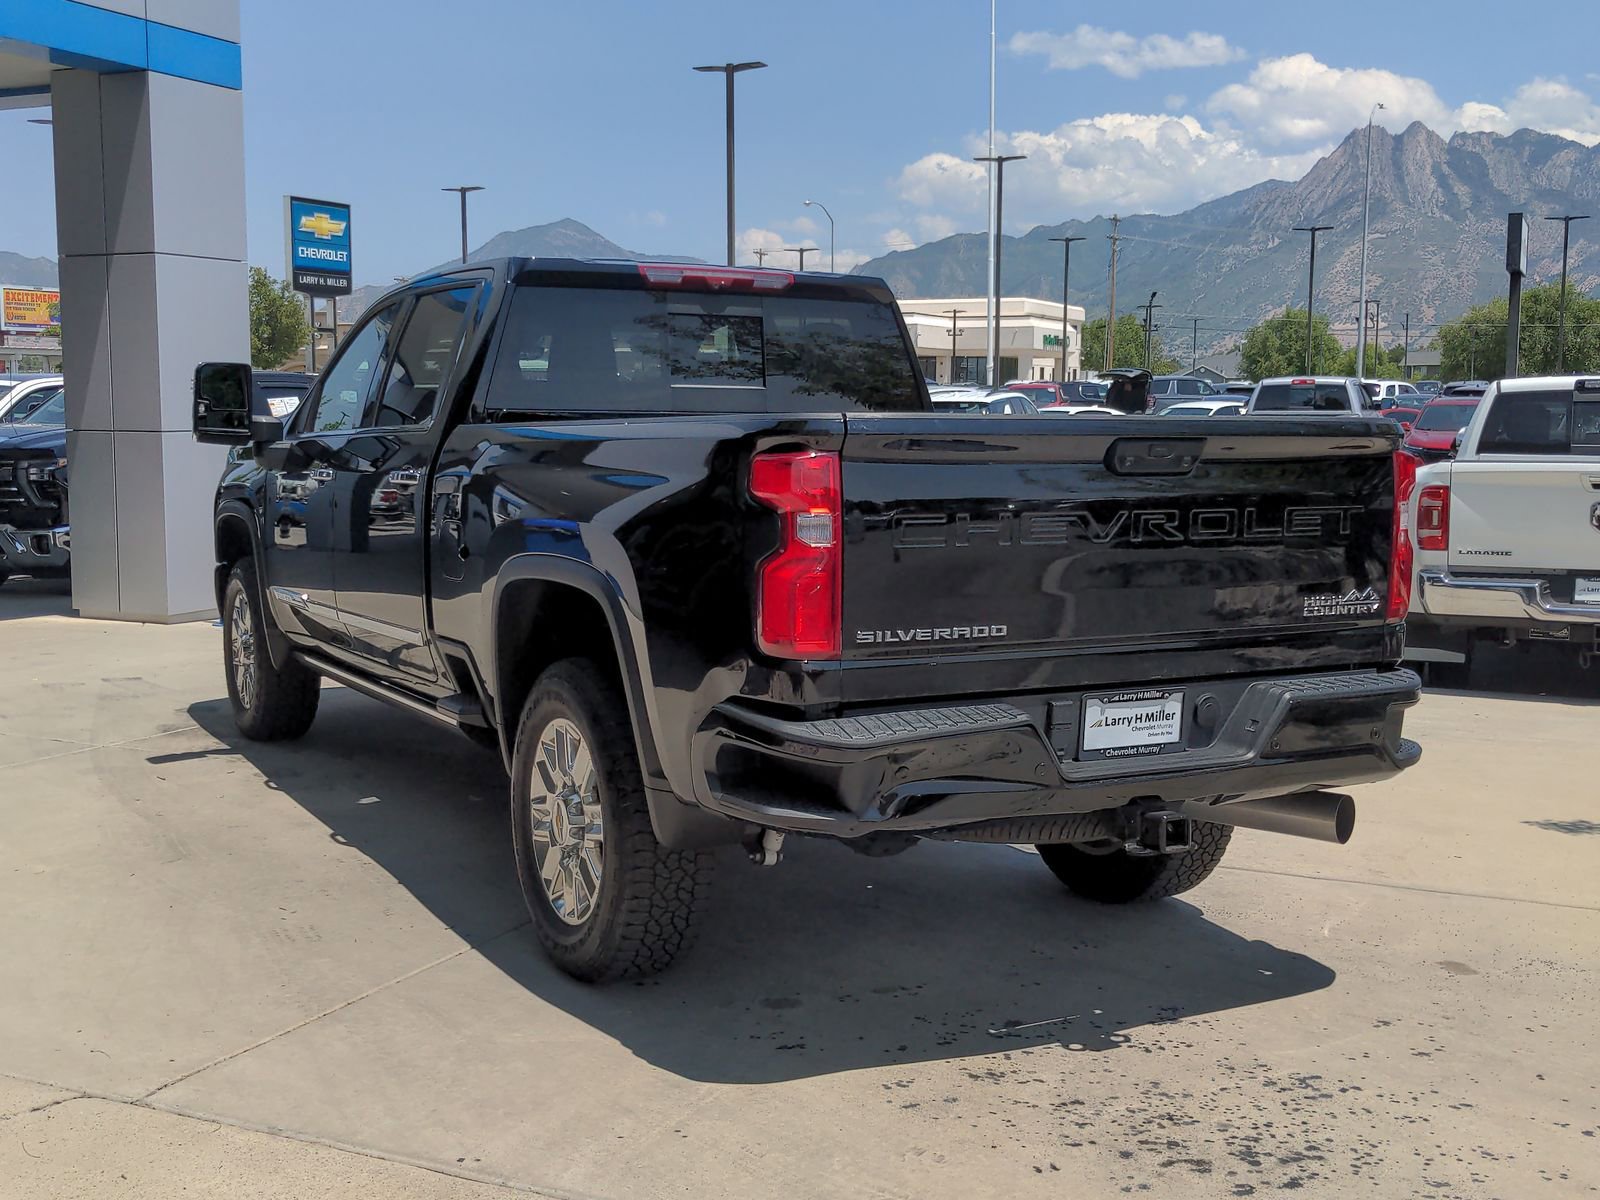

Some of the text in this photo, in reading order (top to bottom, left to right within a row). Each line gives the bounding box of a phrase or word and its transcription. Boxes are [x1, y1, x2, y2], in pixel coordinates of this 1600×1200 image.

[298, 246, 348, 262] CHEVROLET
[299, 275, 348, 287] LARRY H. MILLER
[892, 504, 1365, 549] CHEVROLET
[1458, 549, 1513, 557] LARAMIE
[1304, 595, 1343, 607] HIGH
[1303, 603, 1379, 617] COUNTRY
[856, 625, 1008, 643] SILVERADO
[1120, 692, 1138, 700] Larry
[1143, 690, 1163, 699] Miller
[1104, 716, 1134, 727] Larry
[1144, 710, 1176, 723] Miller
[1131, 724, 1156, 732] Chevrolet
[1105, 745, 1160, 757] Chevrolet Murray
